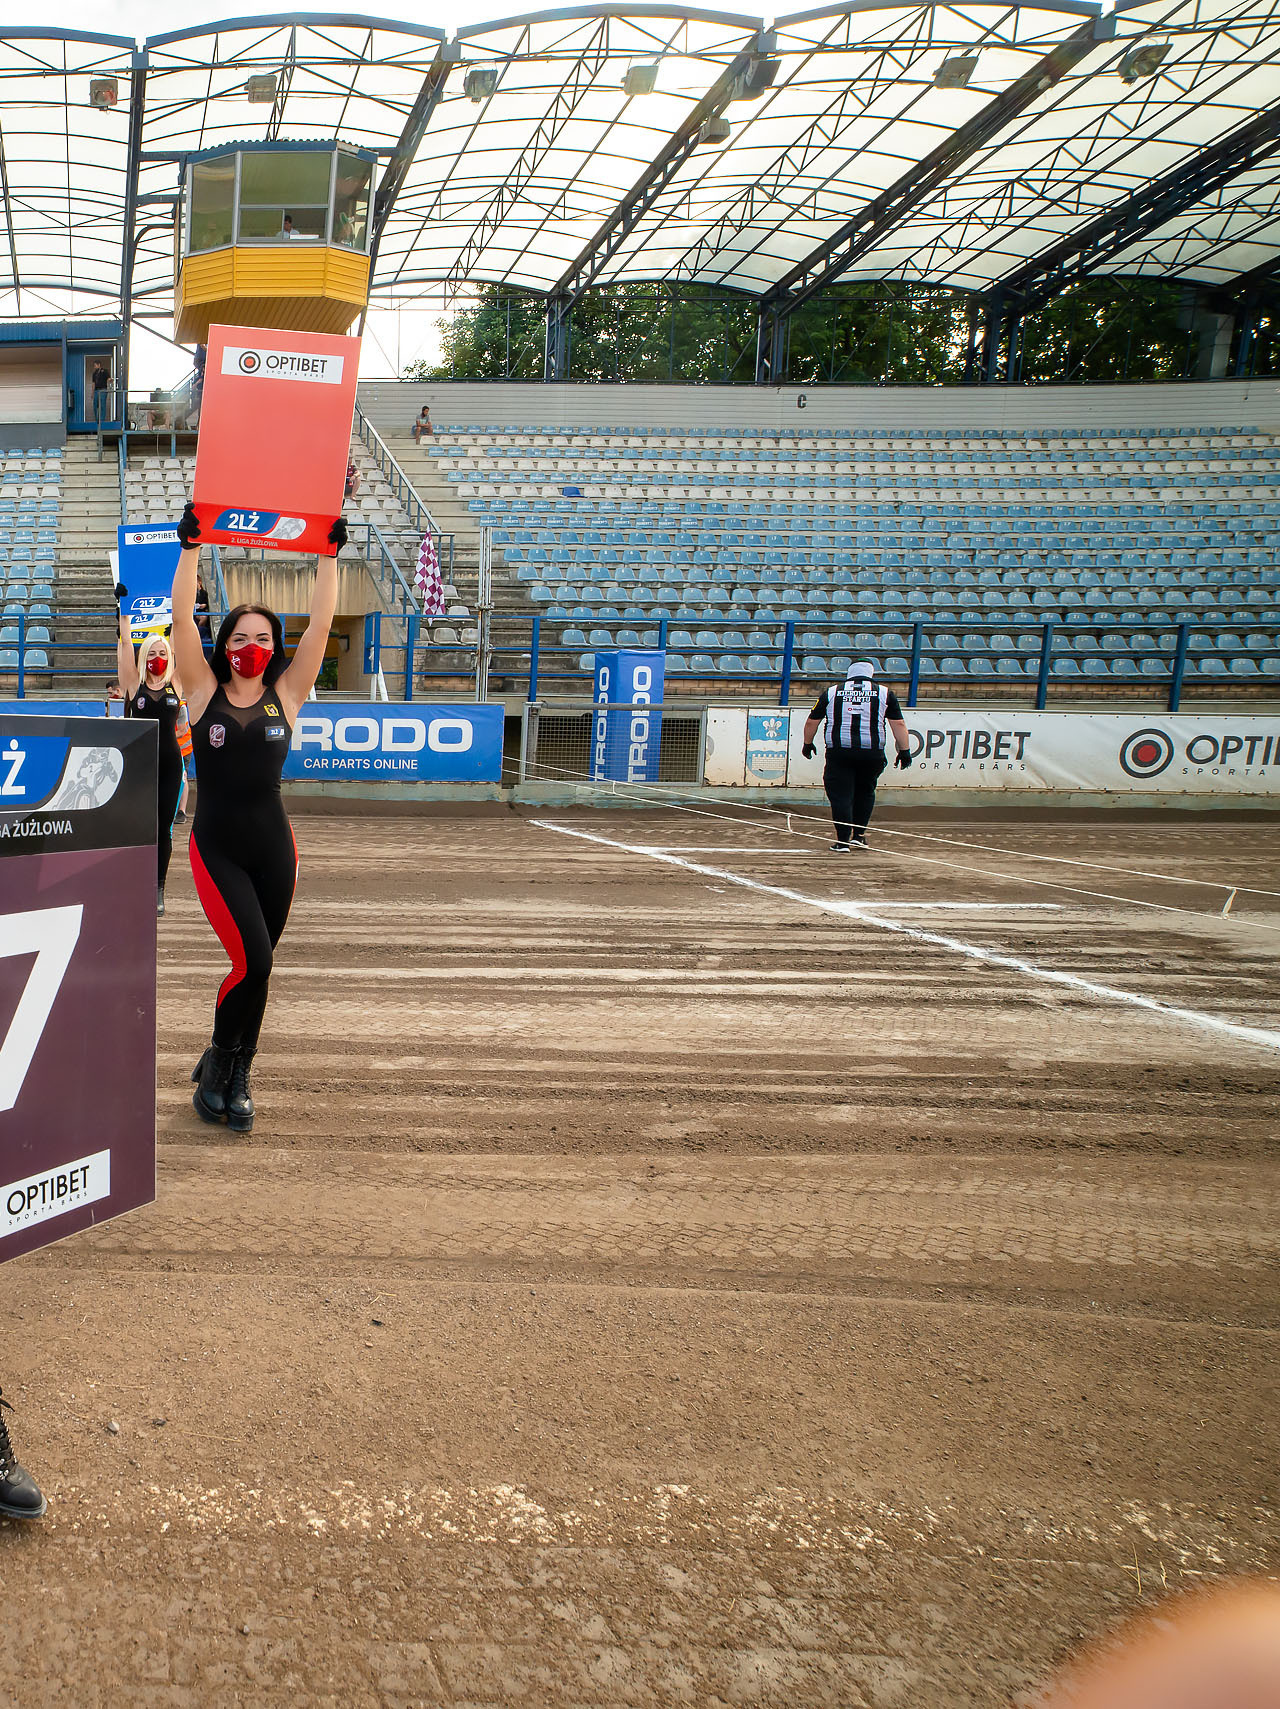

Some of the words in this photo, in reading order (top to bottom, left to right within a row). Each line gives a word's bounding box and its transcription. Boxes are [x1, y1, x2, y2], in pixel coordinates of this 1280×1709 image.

[266, 355, 328, 374] OPTIBET
[797, 394, 807, 409] C
[227, 511, 260, 531] 2LŻ
[146, 532, 176, 540] OPTIBET
[139, 598, 156, 608] 2LŻ
[595, 666, 610, 781] TRODO
[627, 665, 652, 782] TRODO
[290, 717, 473, 753] RODO
[1185, 734, 1280, 766] OPTI
[304, 758, 329, 769] CAR
[332, 758, 371, 769] PARTS
[373, 758, 418, 770] ONLINE
[1182, 767, 1266, 776] SPORTA
[11, 816, 73, 838] ŻUŻLOWA
[6, 1164, 90, 1216] OPTIBET
[8, 1204, 53, 1227] SPORTA
